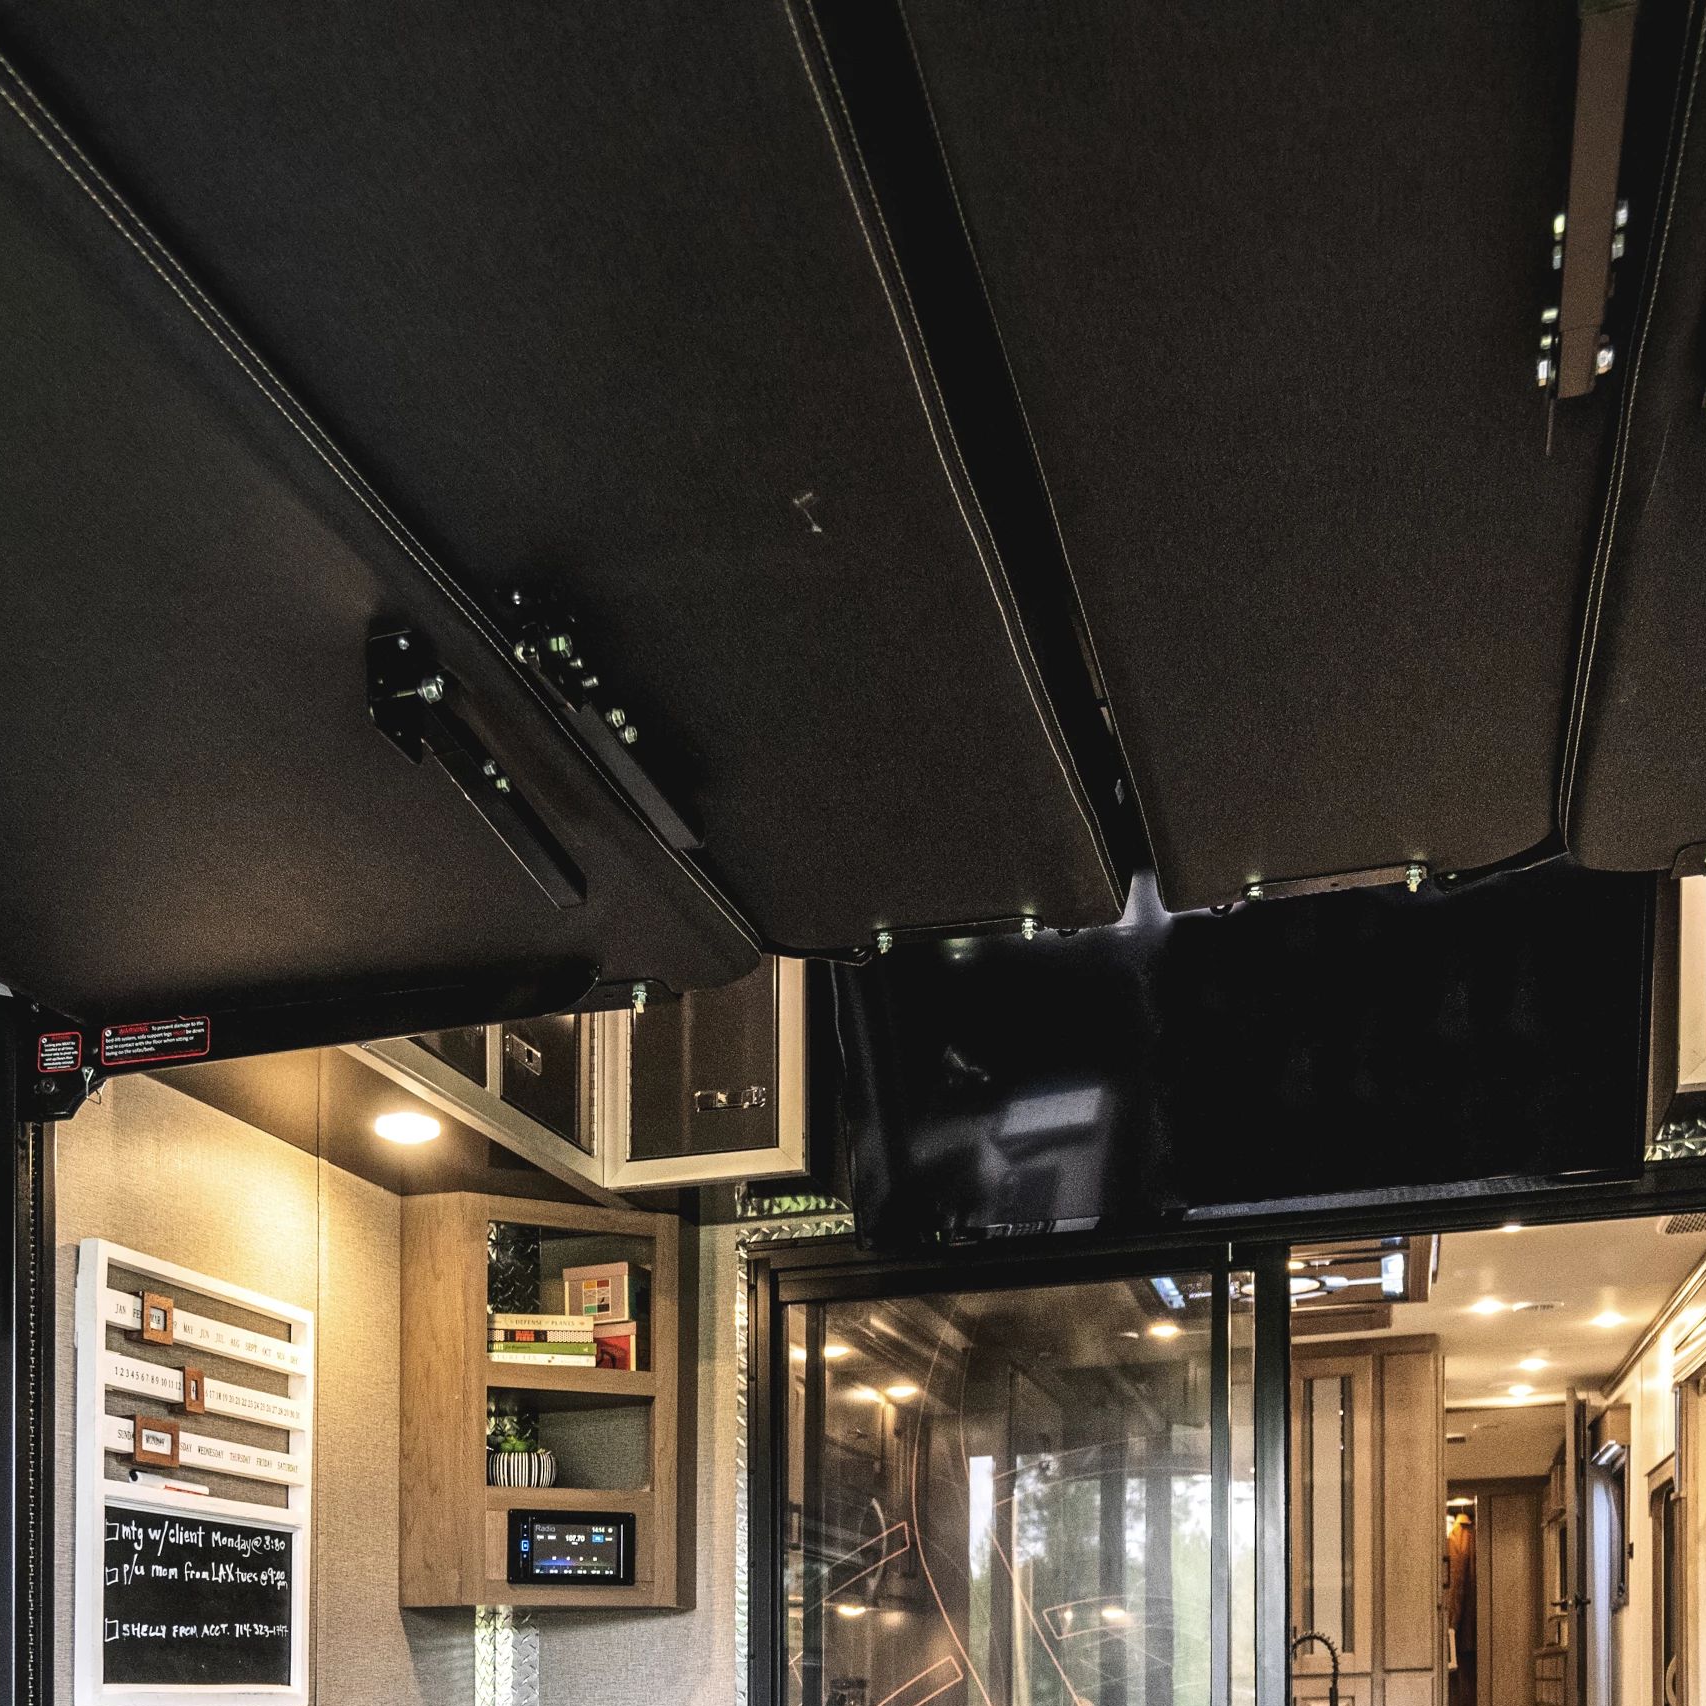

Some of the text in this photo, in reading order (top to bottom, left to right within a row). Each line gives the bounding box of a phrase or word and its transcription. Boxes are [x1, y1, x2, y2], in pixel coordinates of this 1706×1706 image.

[114, 1303, 126, 1314] JAN
[183, 1324, 193, 1334] MAY
[118, 1429, 134, 1441] SUNDA
[180, 1441, 192, 1453] SDAY
[198, 1445, 224, 1459] WEDNESDAY
[122, 1520, 143, 1550] mtg
[535, 1524, 556, 1532] Radio
[124, 1554, 145, 1585] p/u
[152, 1564, 178, 1579] mom
[185, 1562, 209, 1582] from
[122, 1623, 166, 1638] SHELLY
[173, 1625, 198, 1638] FROM
